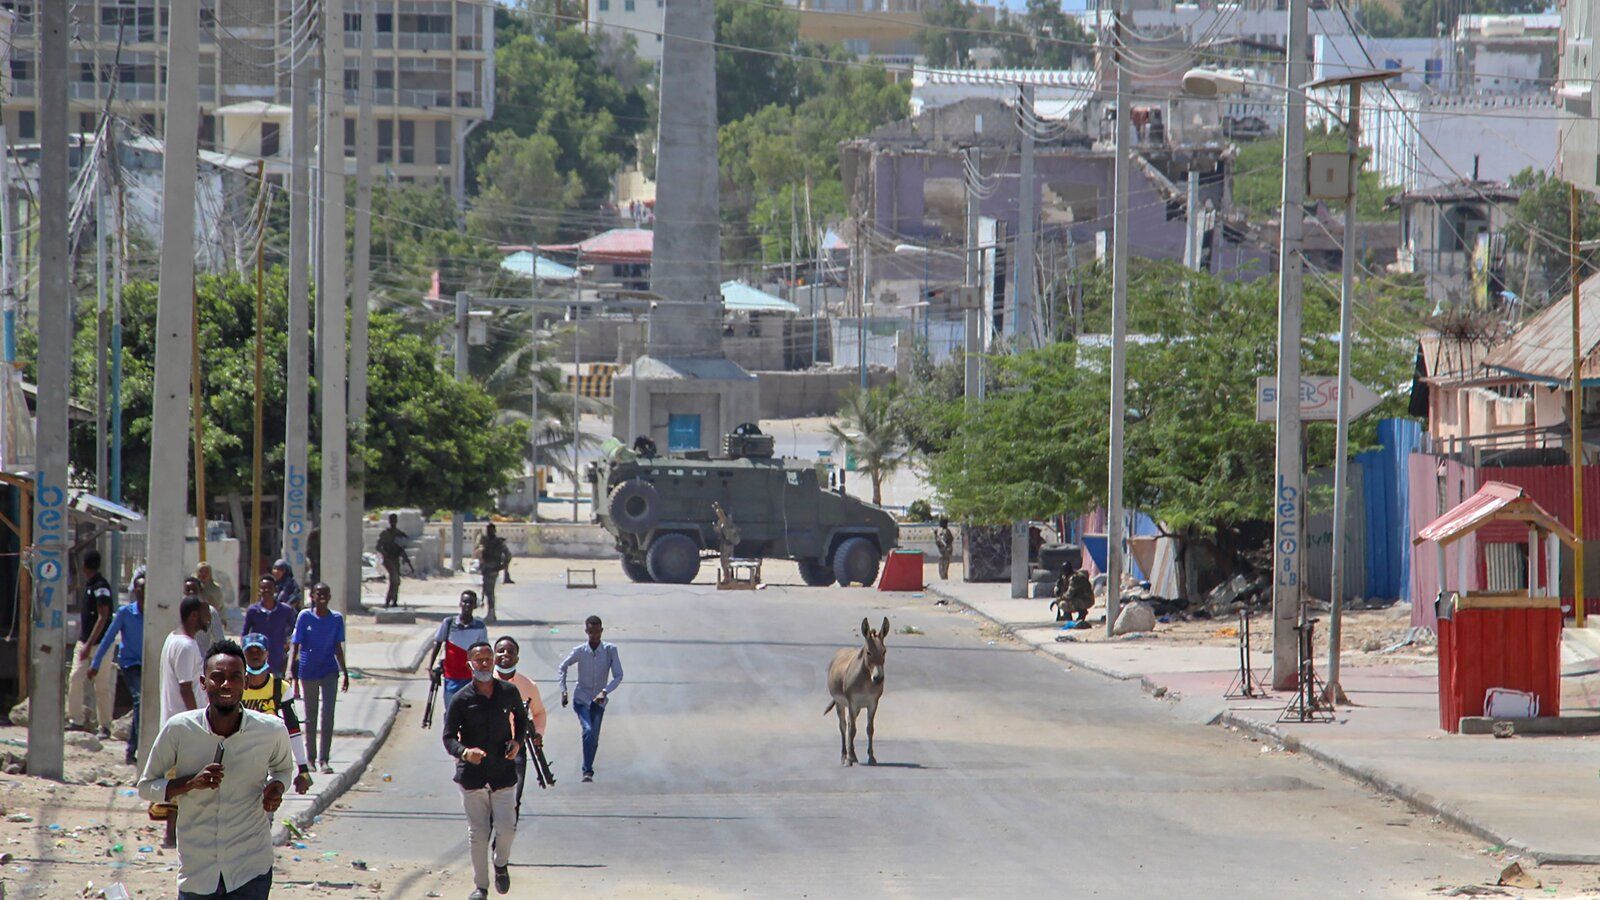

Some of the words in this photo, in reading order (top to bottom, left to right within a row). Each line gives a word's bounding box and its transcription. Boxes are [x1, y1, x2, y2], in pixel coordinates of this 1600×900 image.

[37, 471, 63, 582] beco
[289, 464, 304, 534] beco
[1279, 475, 1297, 555] beco
